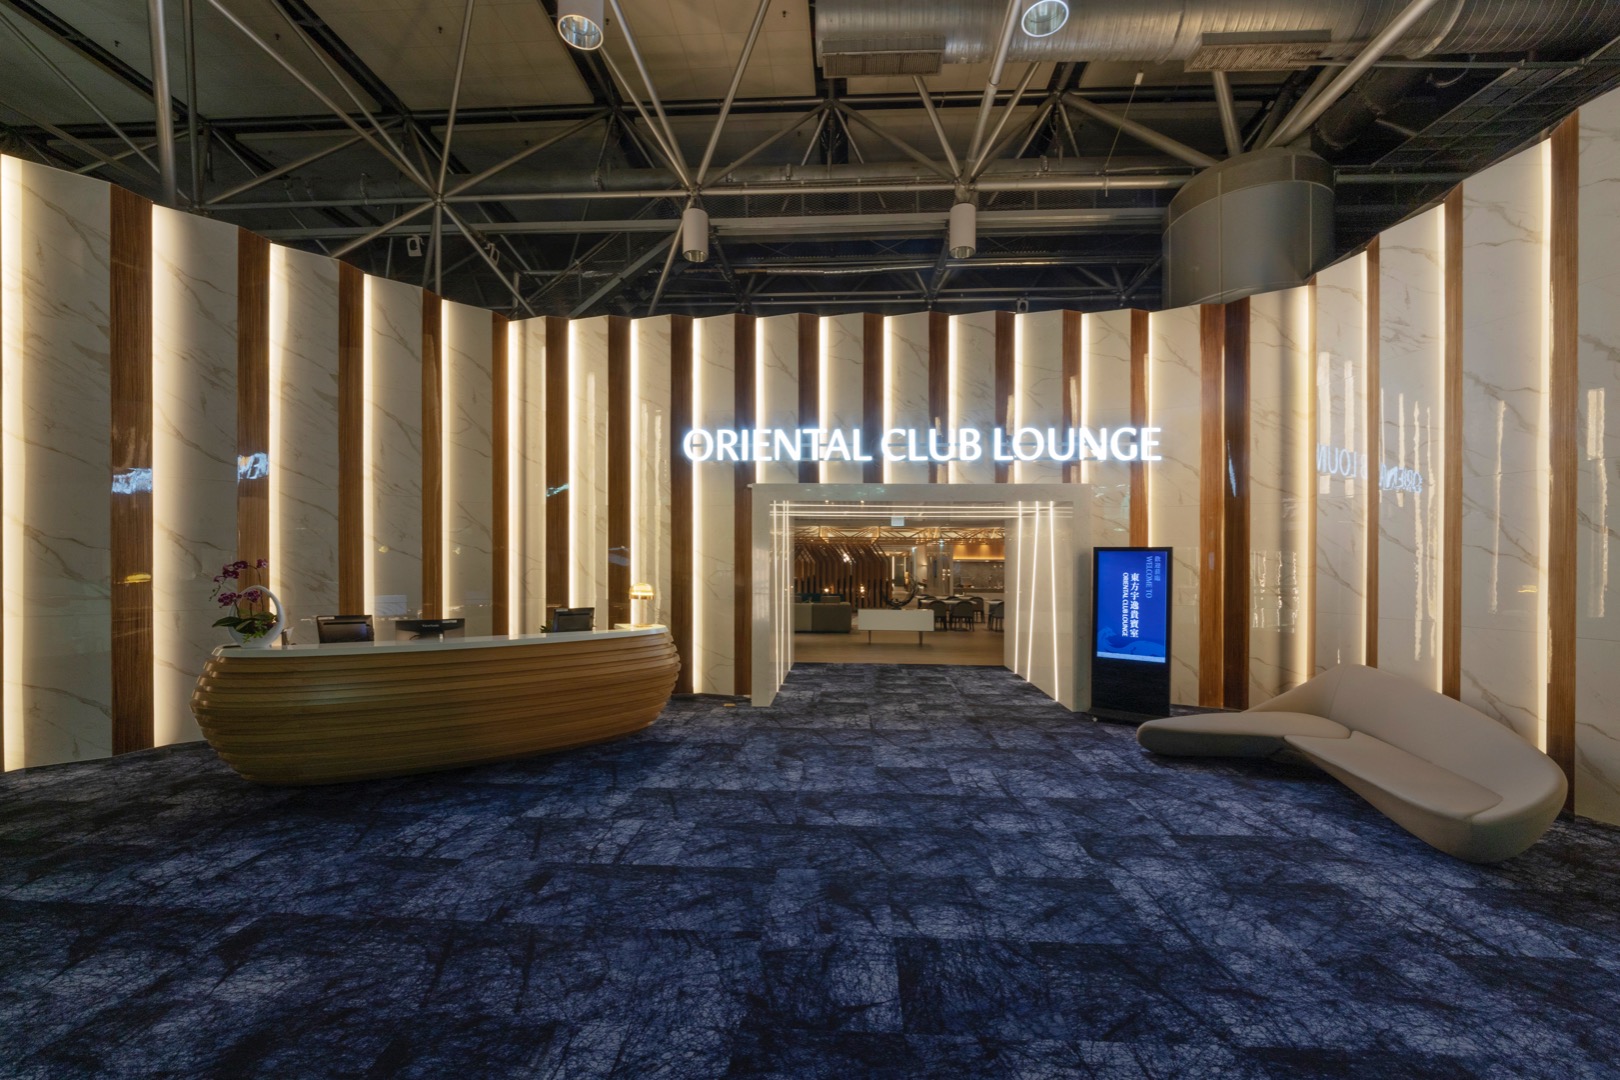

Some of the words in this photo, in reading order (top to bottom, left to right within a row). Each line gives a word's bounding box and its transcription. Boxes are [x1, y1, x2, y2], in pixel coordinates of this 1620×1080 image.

[683, 428, 872, 462] ORIENTAL
[881, 427, 982, 462] CLUB
[993, 427, 1162, 462] LOUNGE
[1145, 556, 1153, 588] WELCOME
[1145, 589, 1153, 599] TO
